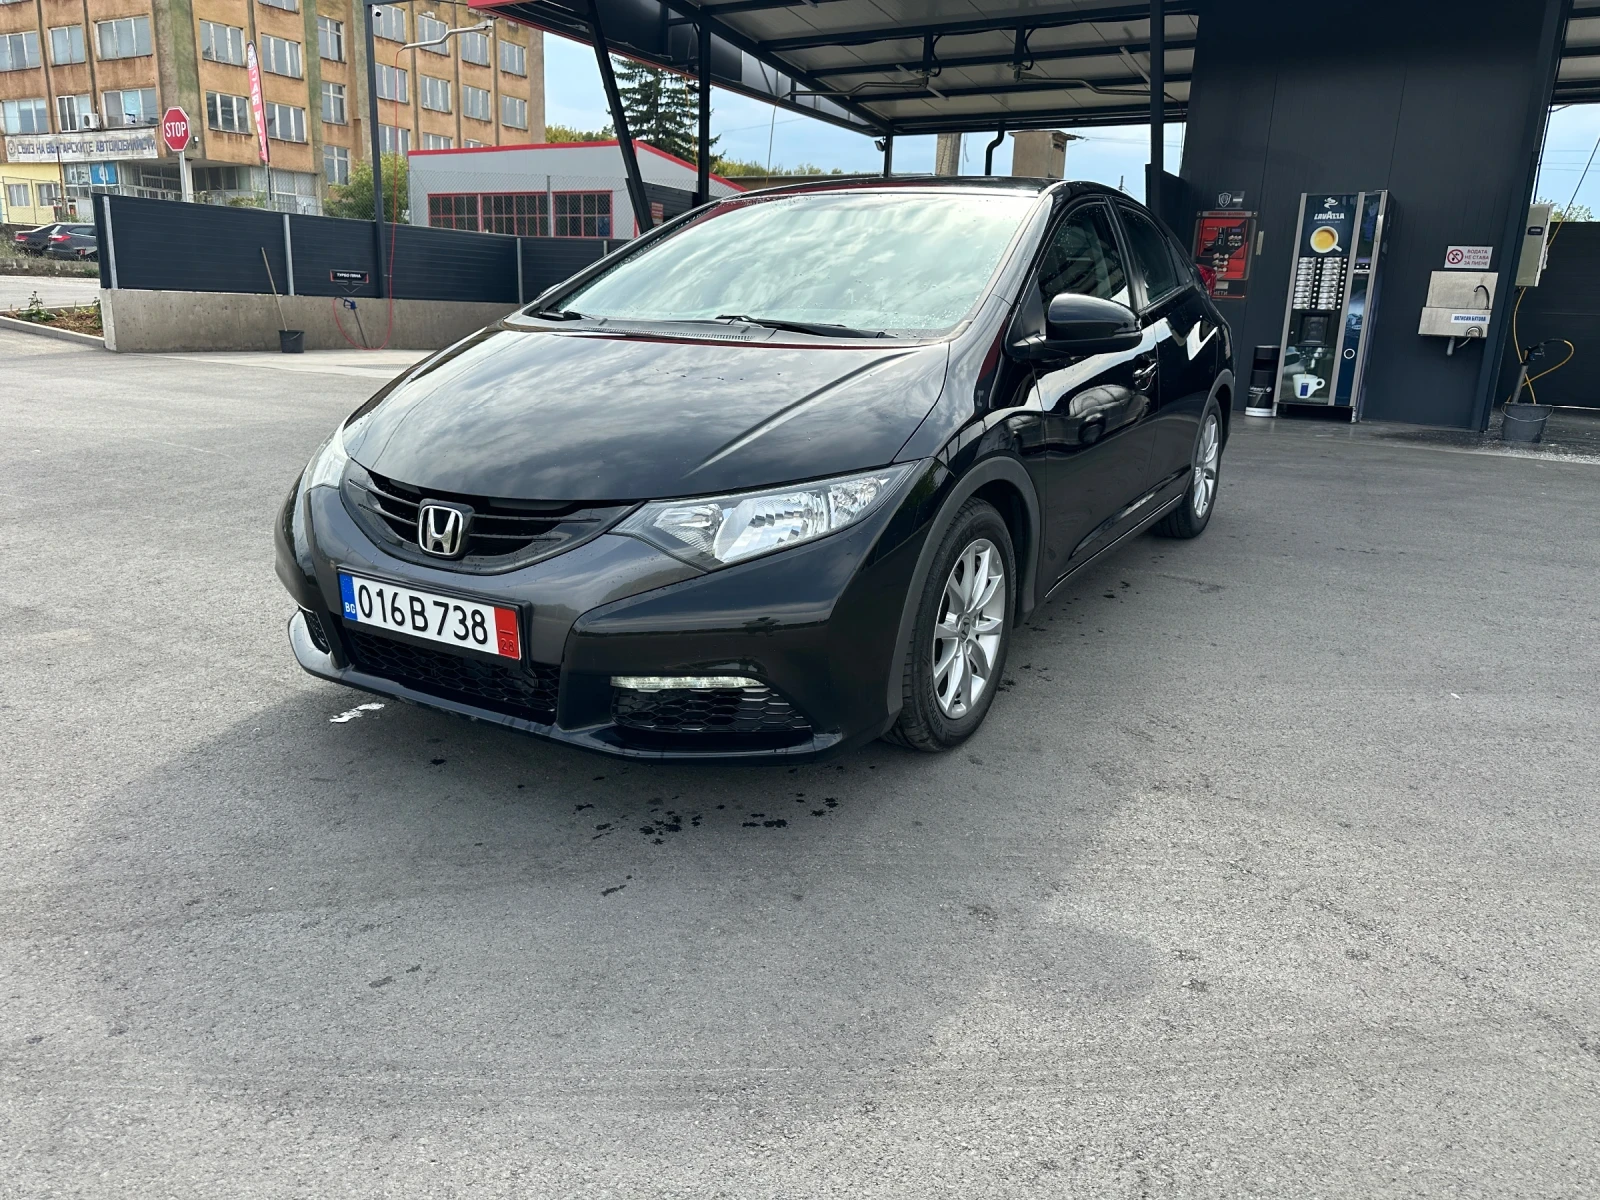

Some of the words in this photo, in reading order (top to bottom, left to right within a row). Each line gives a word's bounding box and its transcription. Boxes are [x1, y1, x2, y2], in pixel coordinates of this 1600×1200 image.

[165, 121, 187, 138] STOP
[36, 143, 46, 154] НА
[344, 601, 356, 615] BG
[358, 584, 489, 646] 016B738
[501, 638, 515, 653] 28
